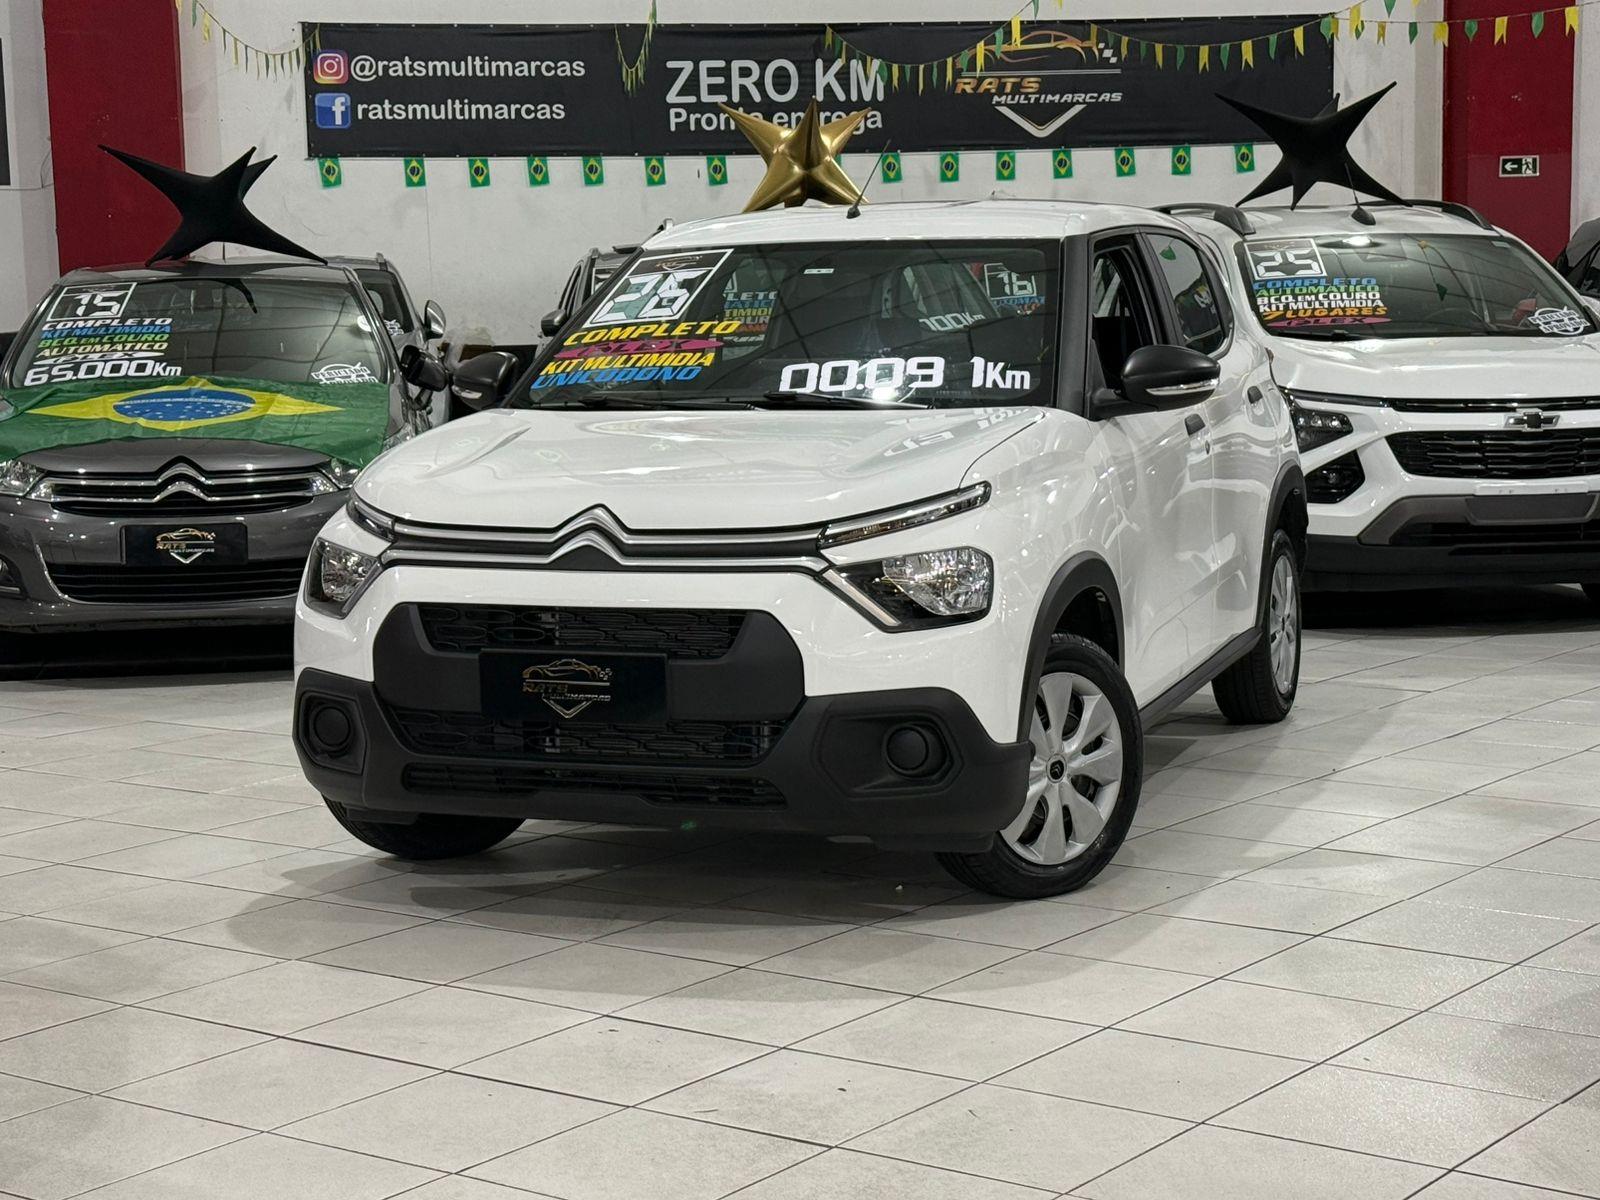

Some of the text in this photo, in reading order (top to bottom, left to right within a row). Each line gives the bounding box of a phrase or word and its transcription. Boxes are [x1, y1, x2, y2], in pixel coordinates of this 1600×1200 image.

[350, 55, 586, 82] @ratsmultimarcas
[665, 58, 885, 103] ZERO KM
[954, 77, 1042, 94] RATS
[992, 93, 1123, 105] MULTIMARCAS
[357, 98, 566, 120] ratsmultimarcas
[669, 107, 763, 132] Pron
[1250, 248, 1322, 277] 25
[1253, 277, 1377, 289] COMPLETO
[1256, 285, 1380, 297] AUTOMATICO
[74, 290, 130, 317] 15
[591, 270, 708, 322] 26
[1297, 294, 1316, 302] EM
[1318, 291, 1381, 301] COURO
[1259, 299, 1385, 313] KIT MULTIMIDIA
[1263, 307, 1388, 320] 7 LUGARES
[41, 325, 172, 340] KIT MULTIMIDIA
[42, 317, 173, 331] COMPLETO
[101, 333, 170, 343] COURO
[563, 320, 743, 346] COMPLETO
[35, 342, 169, 358] AUTOMATICO
[24, 359, 182, 386] 65.000Km
[540, 352, 716, 376] KIT MULTIMIDIA
